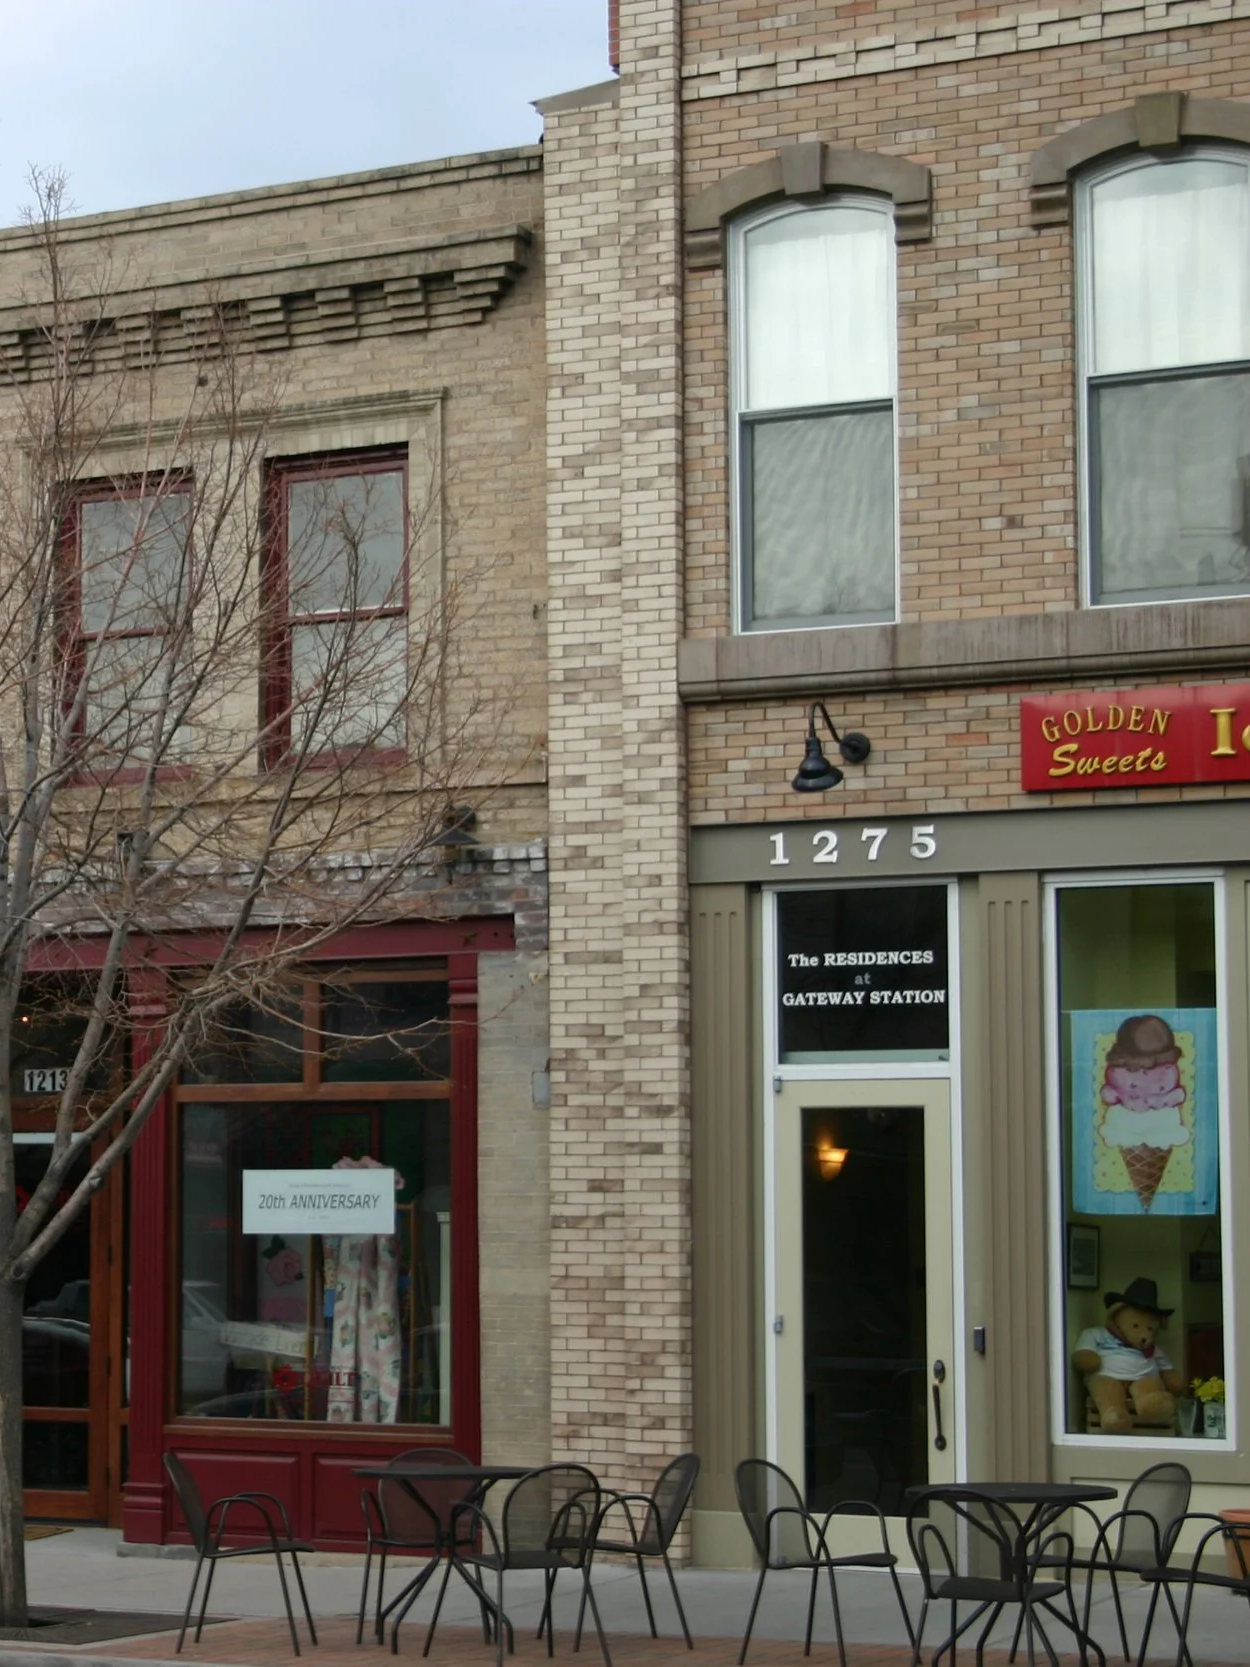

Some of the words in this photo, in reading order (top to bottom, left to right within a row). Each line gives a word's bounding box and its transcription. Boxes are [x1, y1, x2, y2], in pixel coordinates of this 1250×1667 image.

[1041, 705, 1172, 742] GOLDEN
[1048, 743, 1167, 777] Sweets
[769, 825, 937, 865] 1275
[788, 954, 819, 967] The
[823, 951, 934, 967] RESIDENCES
[854, 972, 871, 985] at
[782, 991, 865, 1006] GATEWAY
[869, 989, 946, 1004] STATION
[26, 1070, 68, 1092] 1213
[258, 1194, 286, 1210] 20th
[290, 1193, 380, 1210] ANNIVERSARY
